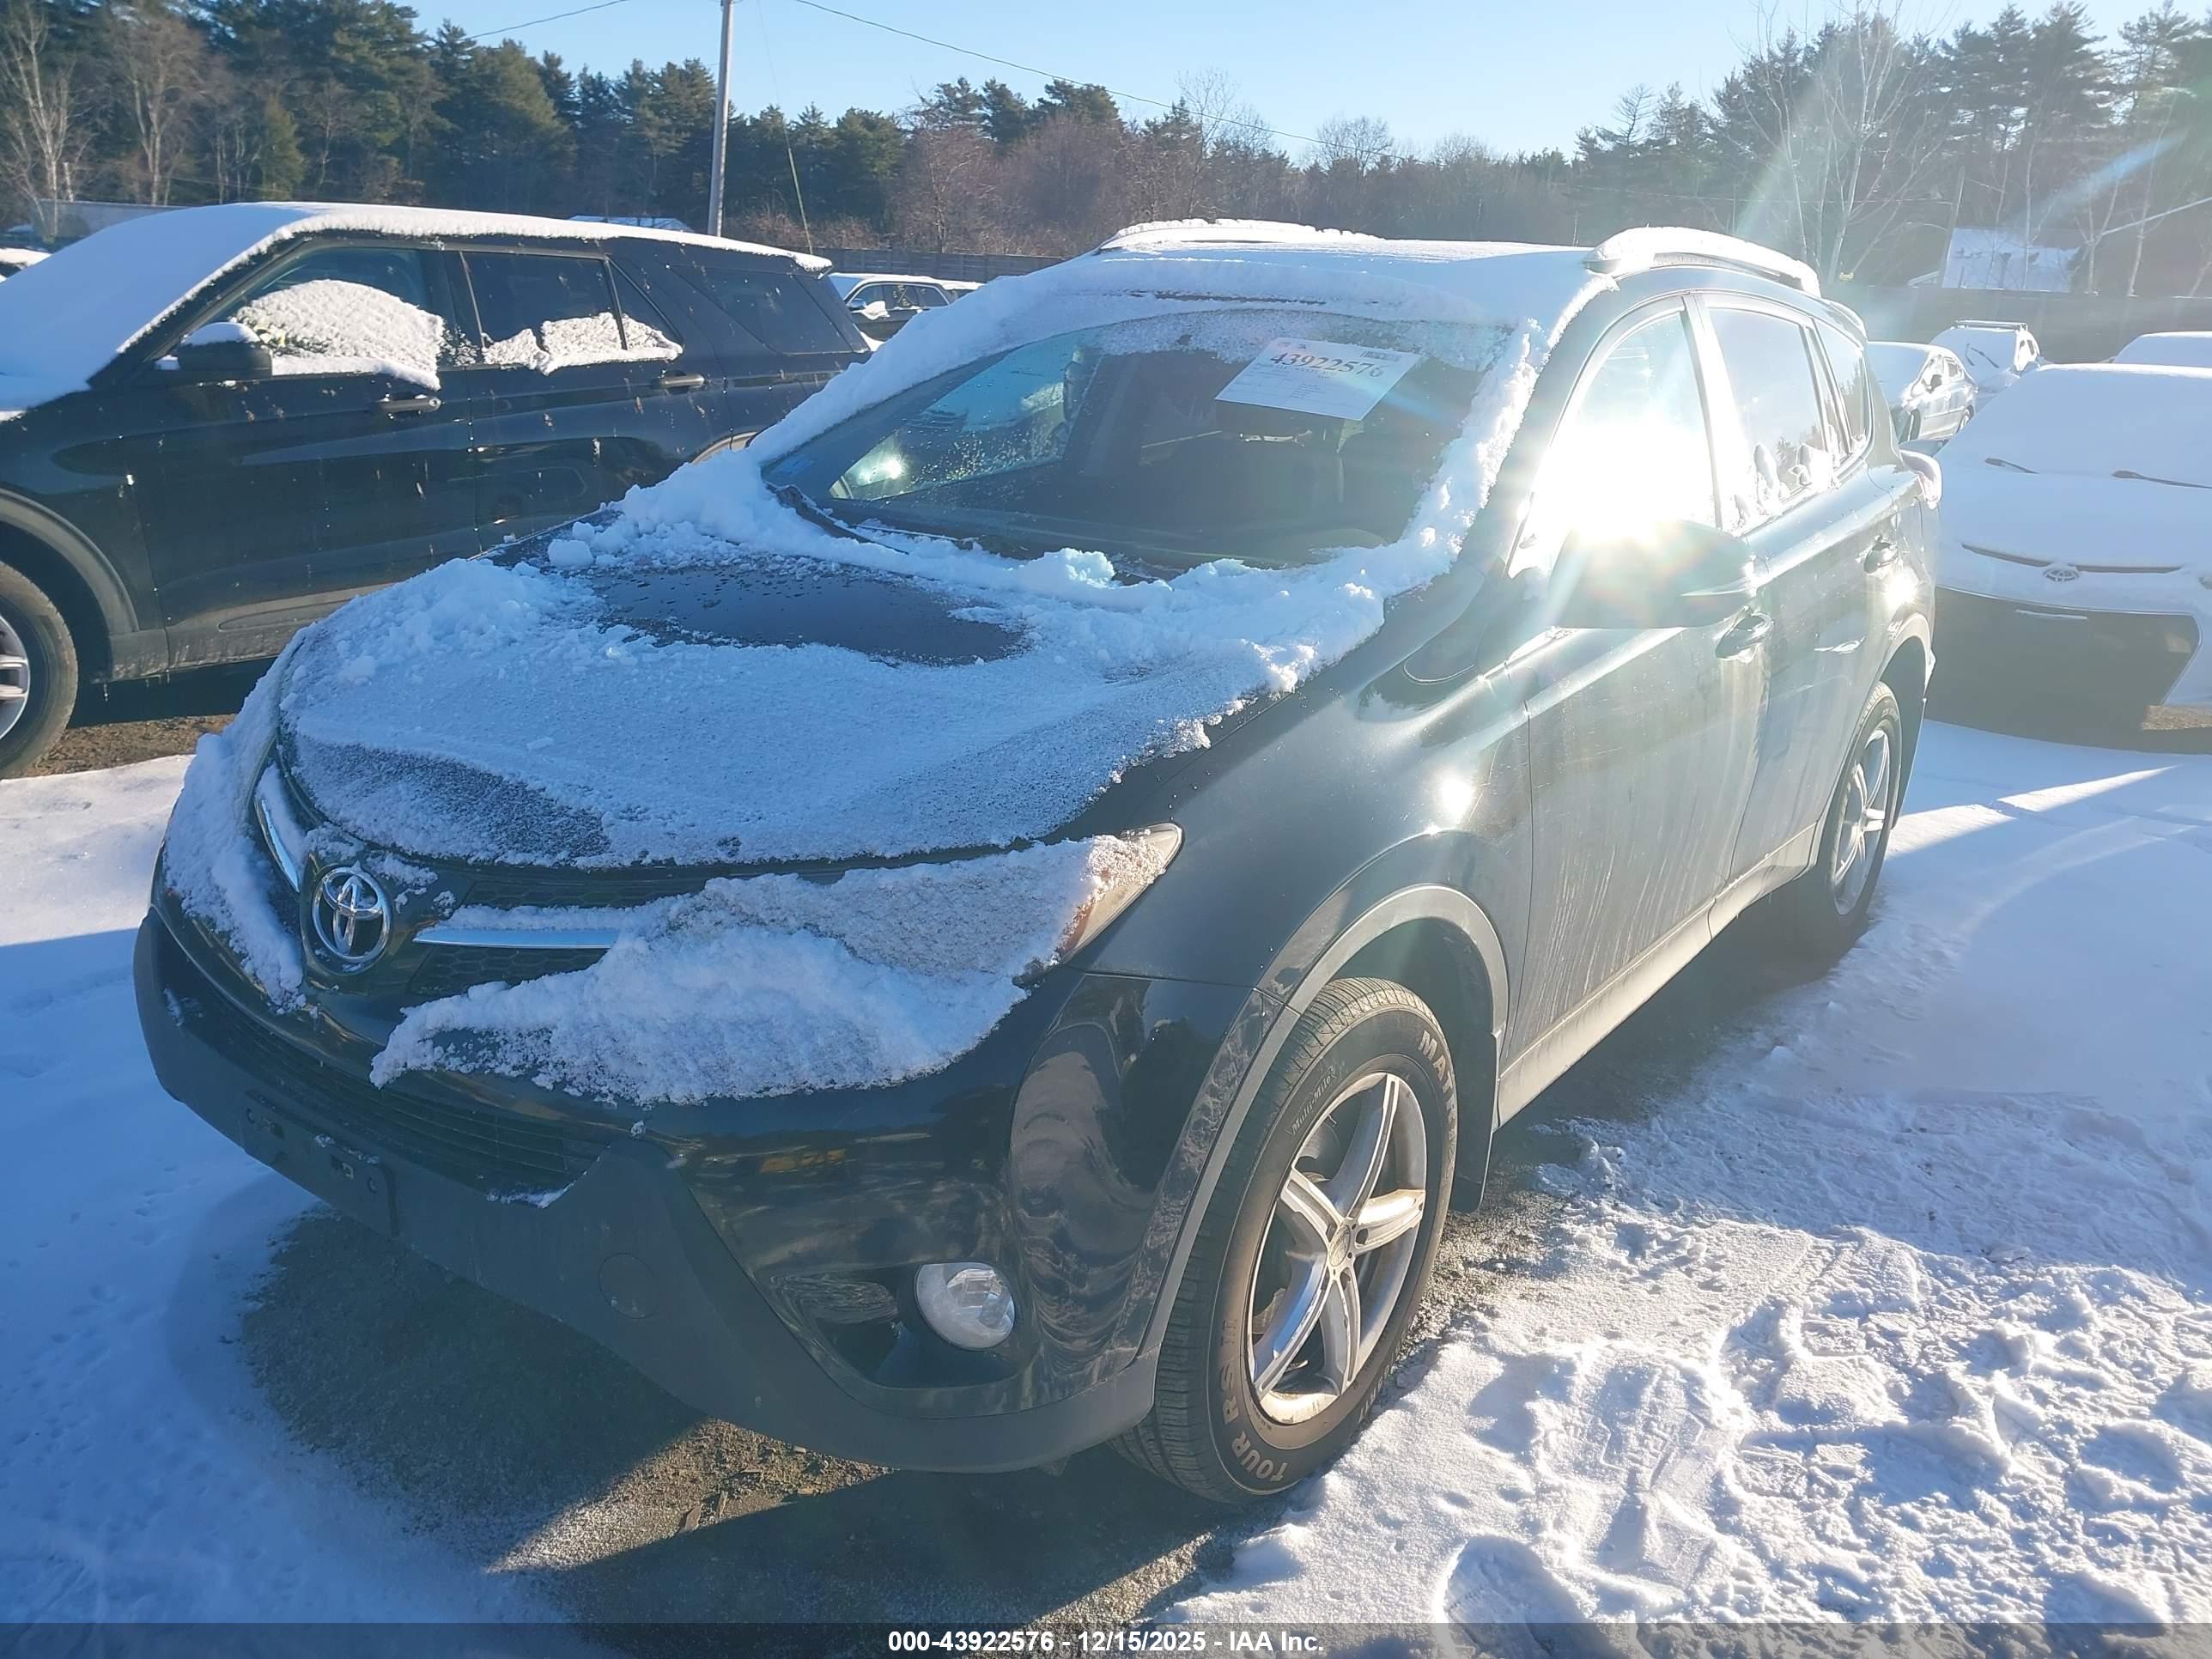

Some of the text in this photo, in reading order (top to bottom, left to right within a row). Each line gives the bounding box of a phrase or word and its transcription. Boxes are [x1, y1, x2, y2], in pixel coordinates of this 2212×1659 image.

[1270, 352, 1386, 378] 43922576
[1220, 1364, 1239, 1425] RS
[1231, 1431, 1288, 1481] TOUR
